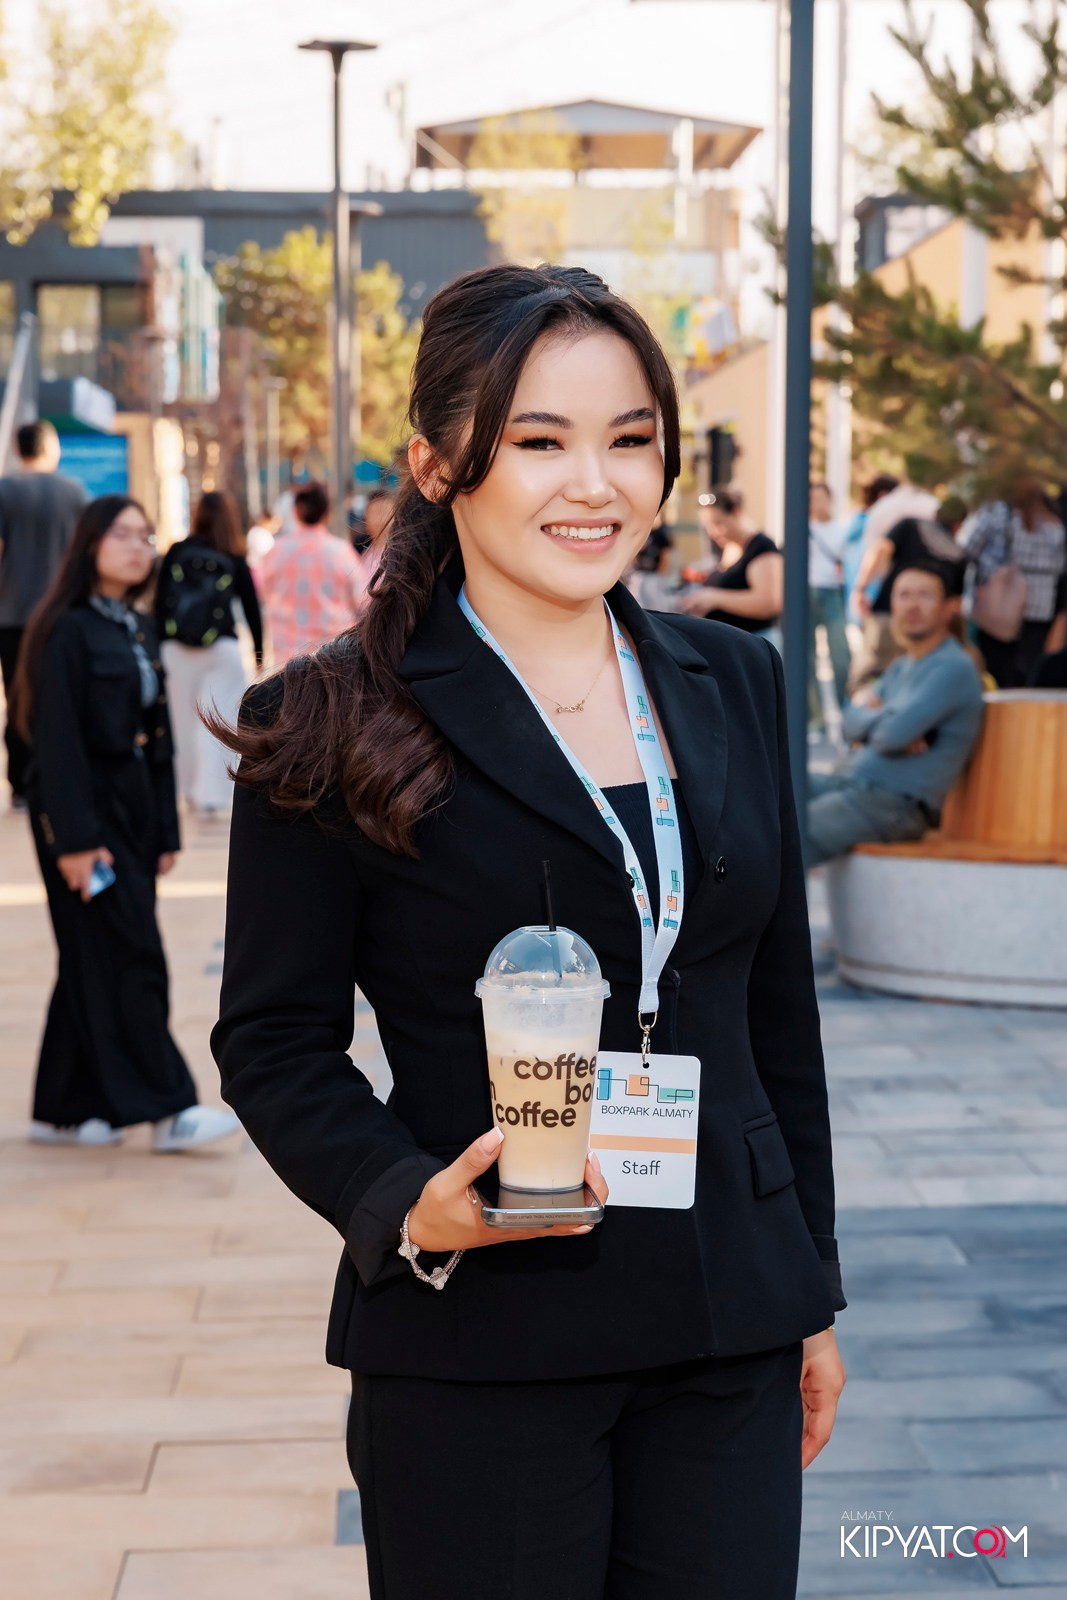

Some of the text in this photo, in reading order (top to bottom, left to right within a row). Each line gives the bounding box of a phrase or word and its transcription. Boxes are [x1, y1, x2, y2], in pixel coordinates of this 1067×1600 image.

[513, 1052, 596, 1080] coffee
[565, 1080, 594, 1105] bo
[495, 1101, 576, 1128] coffee
[601, 1105, 694, 1118] BOXPARK ALMATY
[622, 1160, 661, 1175] Staff
